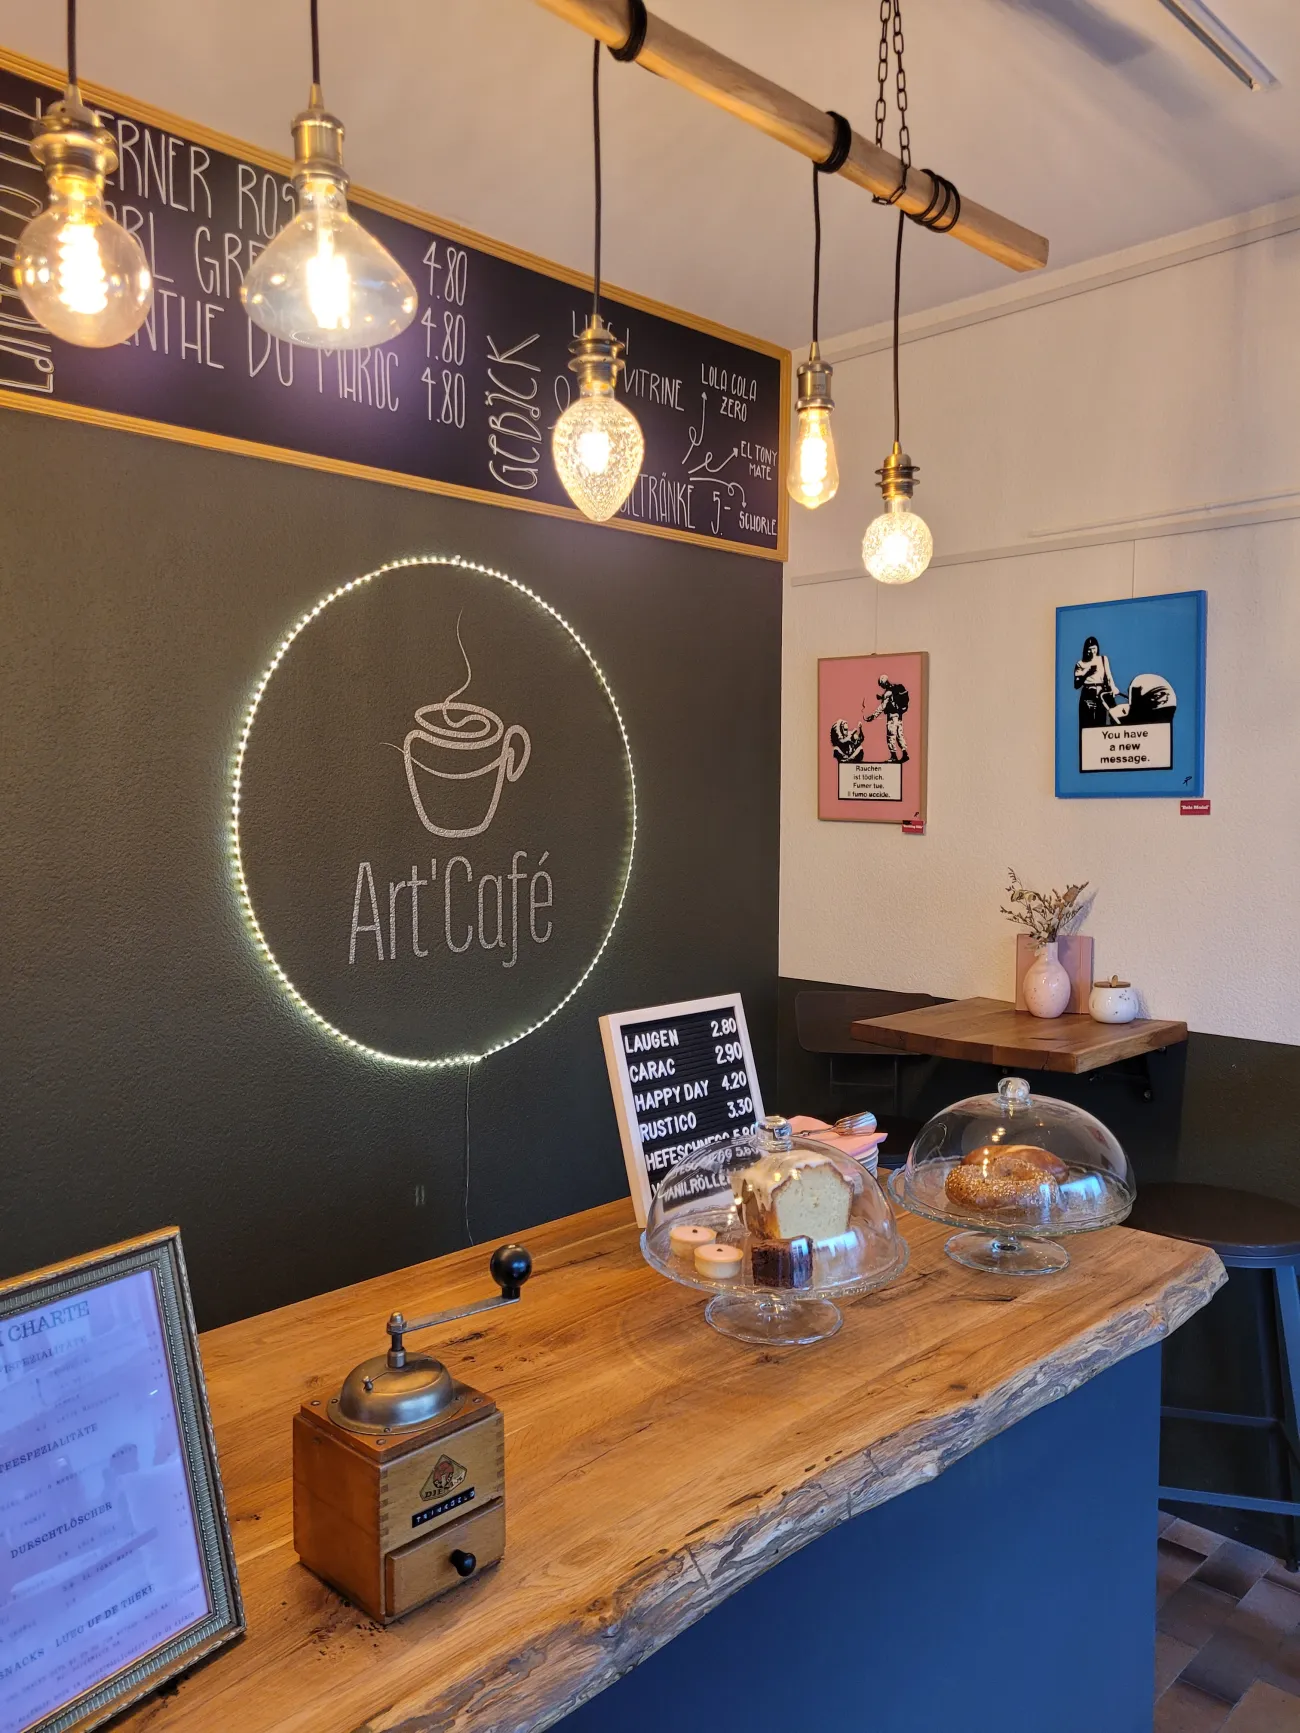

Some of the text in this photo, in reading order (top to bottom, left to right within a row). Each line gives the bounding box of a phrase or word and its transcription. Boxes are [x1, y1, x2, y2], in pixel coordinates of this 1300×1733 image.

[238, 163, 297, 239] ROS
[423, 241, 468, 306] 4.80
[420, 307, 466, 366] 4.80
[421, 367, 466, 430] 4.80
[623, 364, 685, 412] VITRINE
[701, 363, 757, 402] LOLA COLA
[720, 396, 748, 423] ZERO
[740, 440, 778, 467] EL TONY
[748, 462, 773, 481] MATE
[738, 510, 777, 536] SCHORLE
[1101, 729, 1149, 740] You have
[1109, 742, 1141, 751] a new
[1100, 753, 1150, 764] message.
[349, 850, 553, 968] Art'Café
[624, 1017, 737, 1054] LAUGEN 2.80
[629, 1058, 676, 1083] CARAC
[635, 1070, 747, 1112] HAPPY DAY 4.20
[640, 1097, 753, 1143] RUSTICO 3.30
[7, 1300, 91, 1342] CHARTE
[10, 1501, 113, 1559] DURSCHTLÖSCHER
